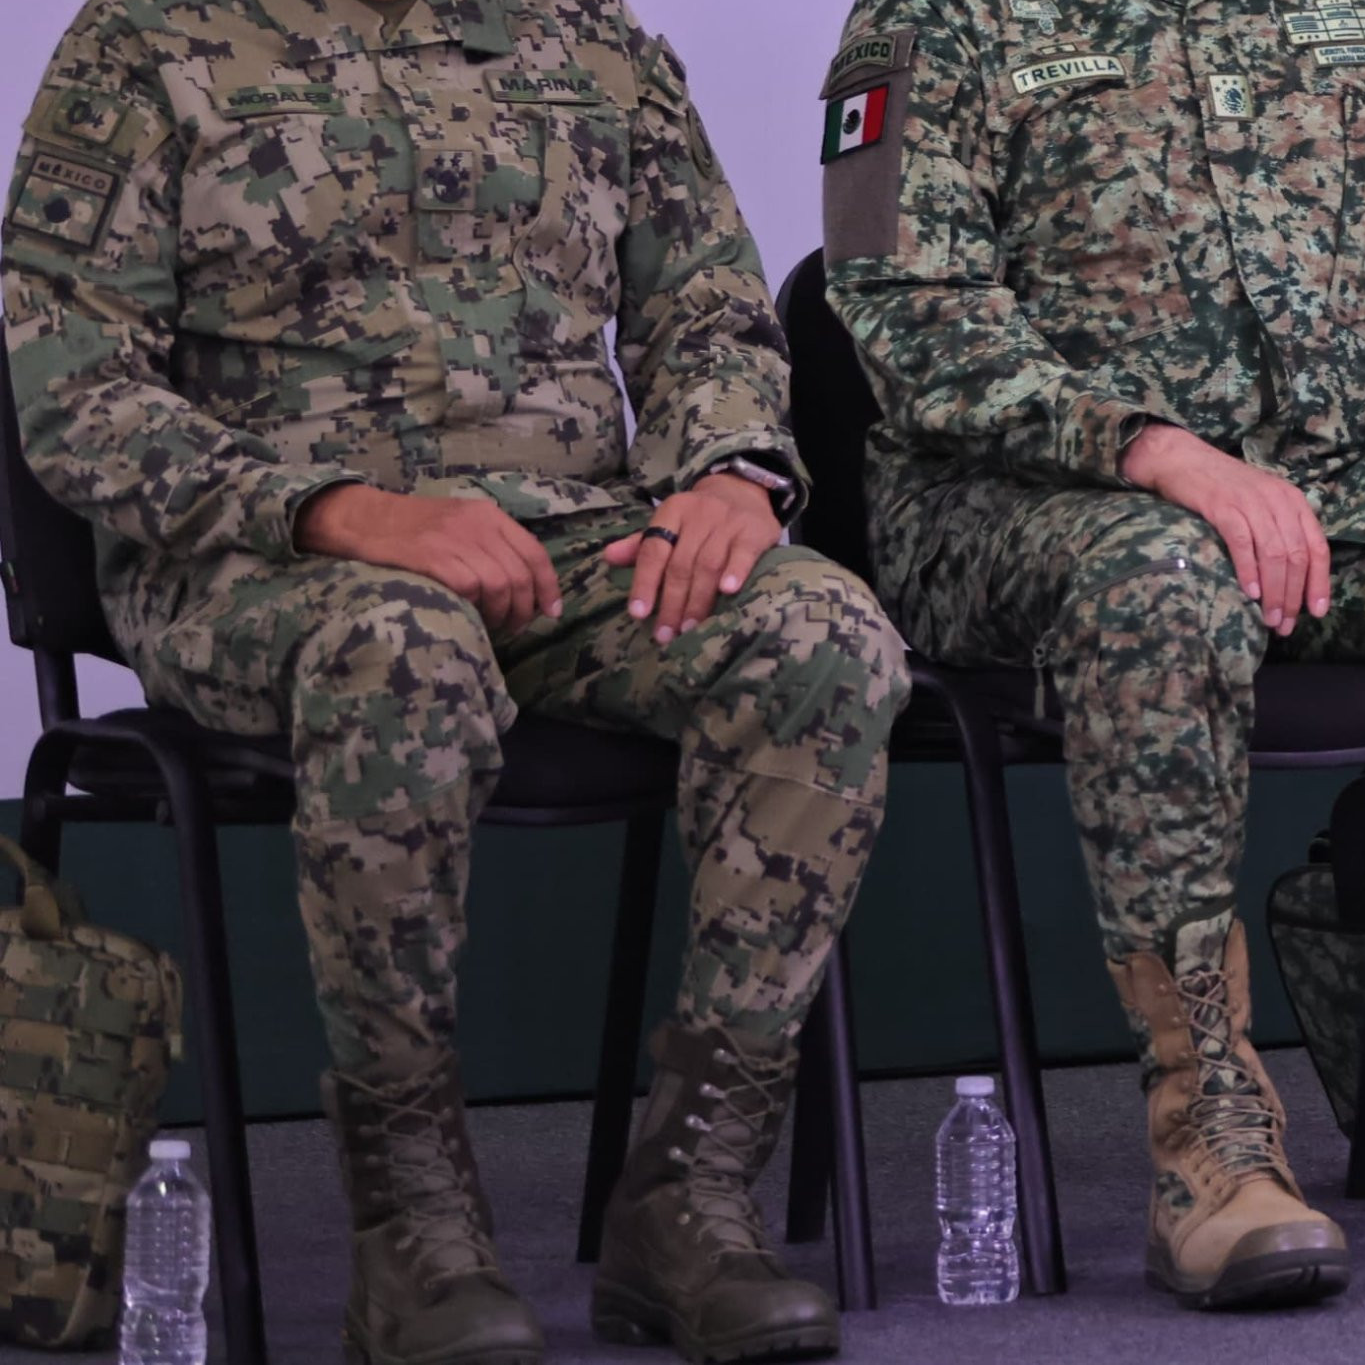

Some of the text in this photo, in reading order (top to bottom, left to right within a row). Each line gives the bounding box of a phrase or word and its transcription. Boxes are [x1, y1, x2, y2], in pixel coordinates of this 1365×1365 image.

[1018, 59, 1120, 87] TREVILLA
[498, 77, 593, 93] MARINA
[226, 91, 331, 106] MORALES
